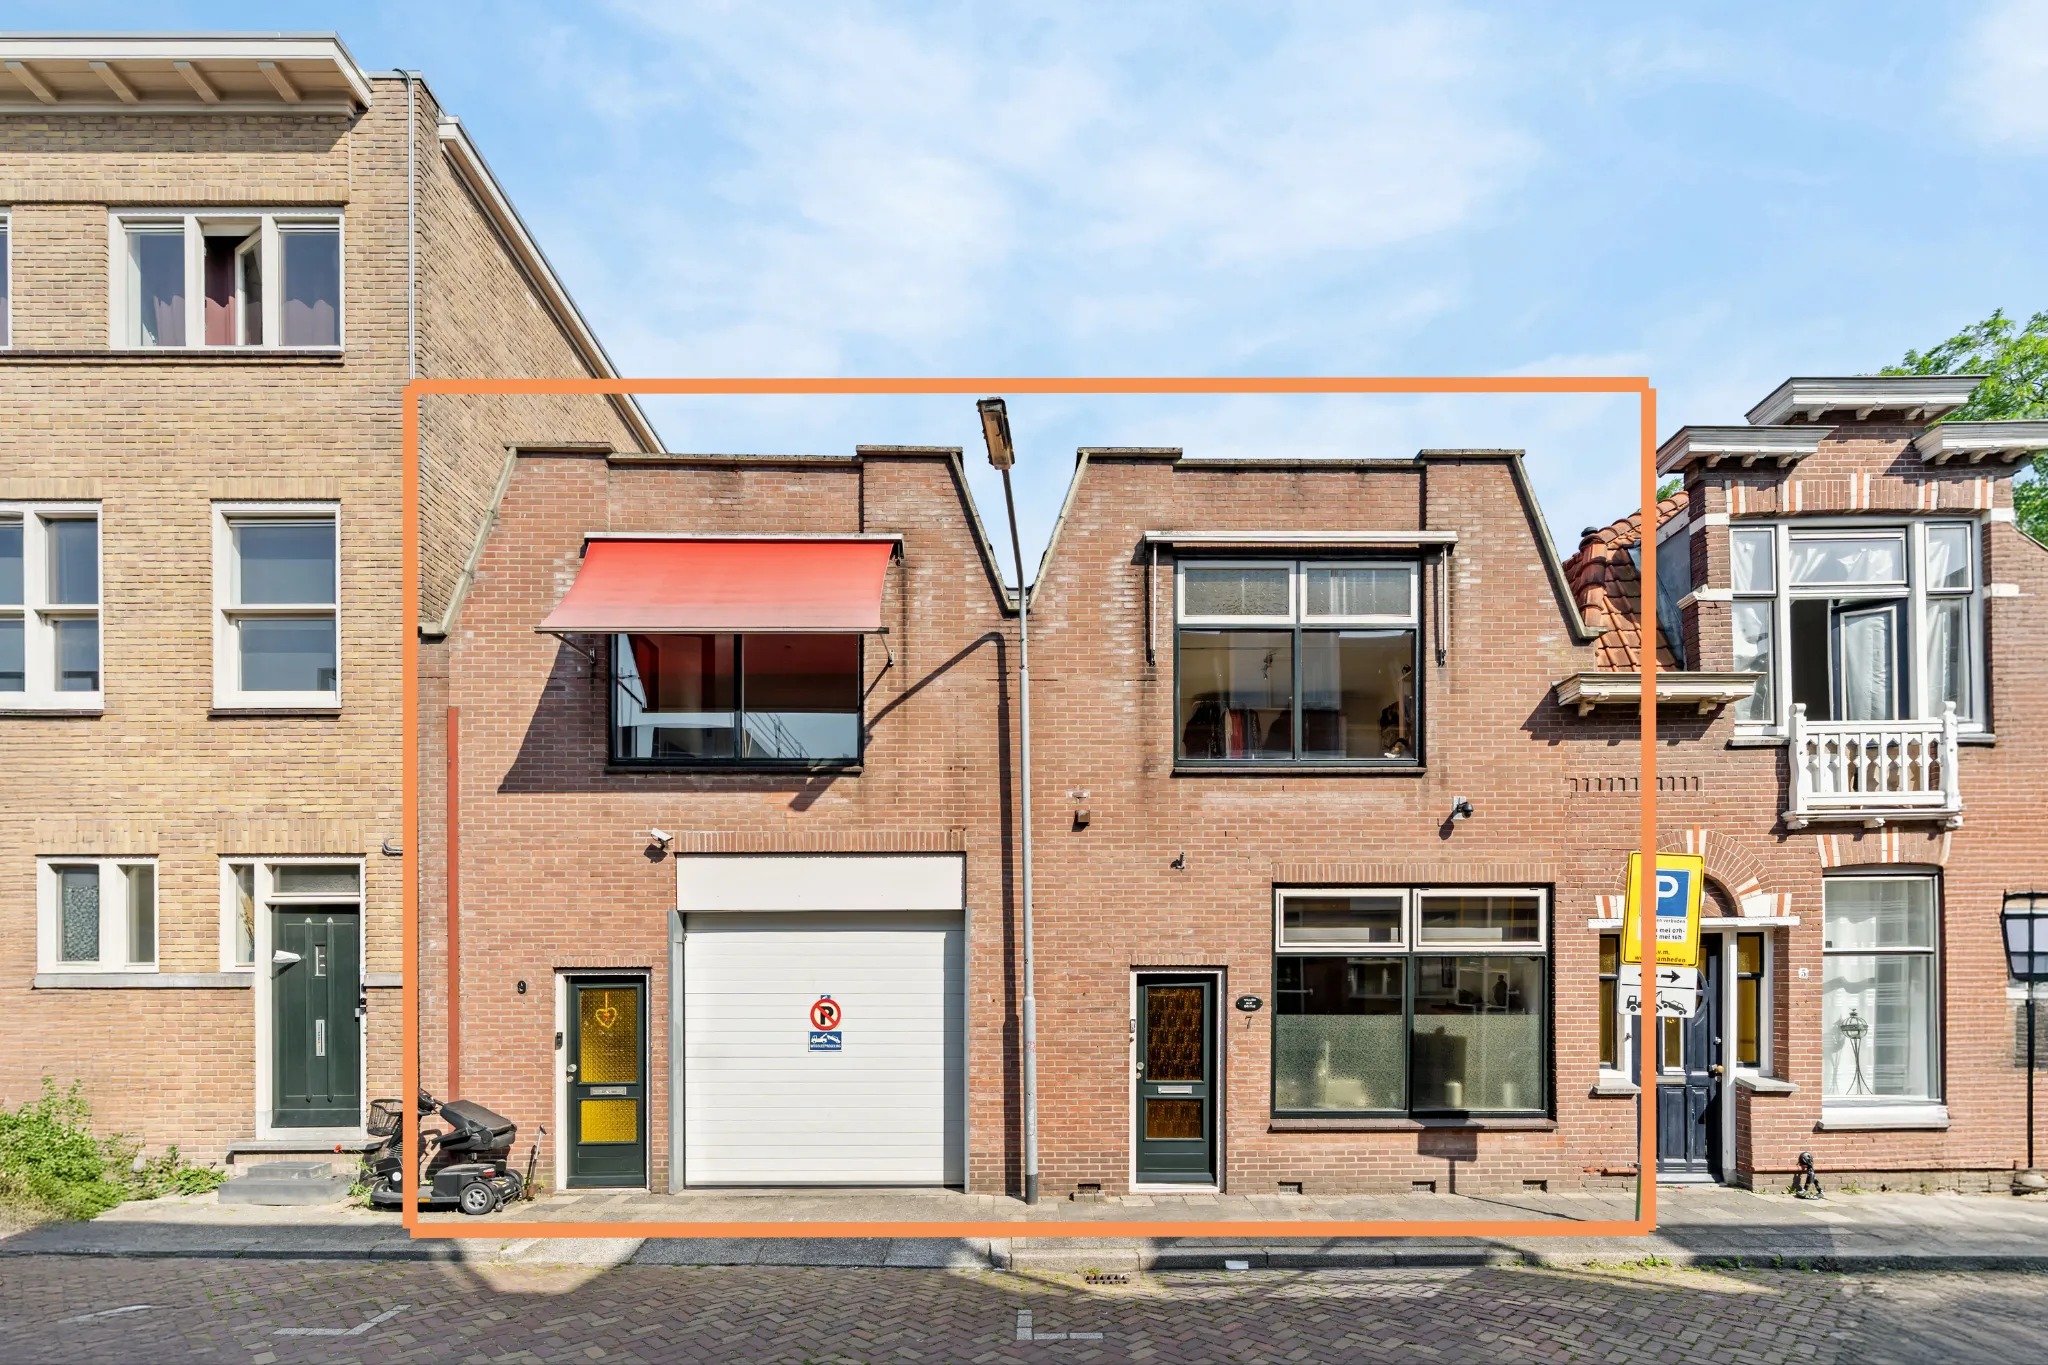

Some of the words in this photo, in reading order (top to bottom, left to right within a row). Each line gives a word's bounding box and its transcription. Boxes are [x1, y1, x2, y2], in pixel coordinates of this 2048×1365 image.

[1656, 876, 1679, 910] P
[820, 1005, 834, 1025] P
[1244, 1015, 1253, 1029] 7
